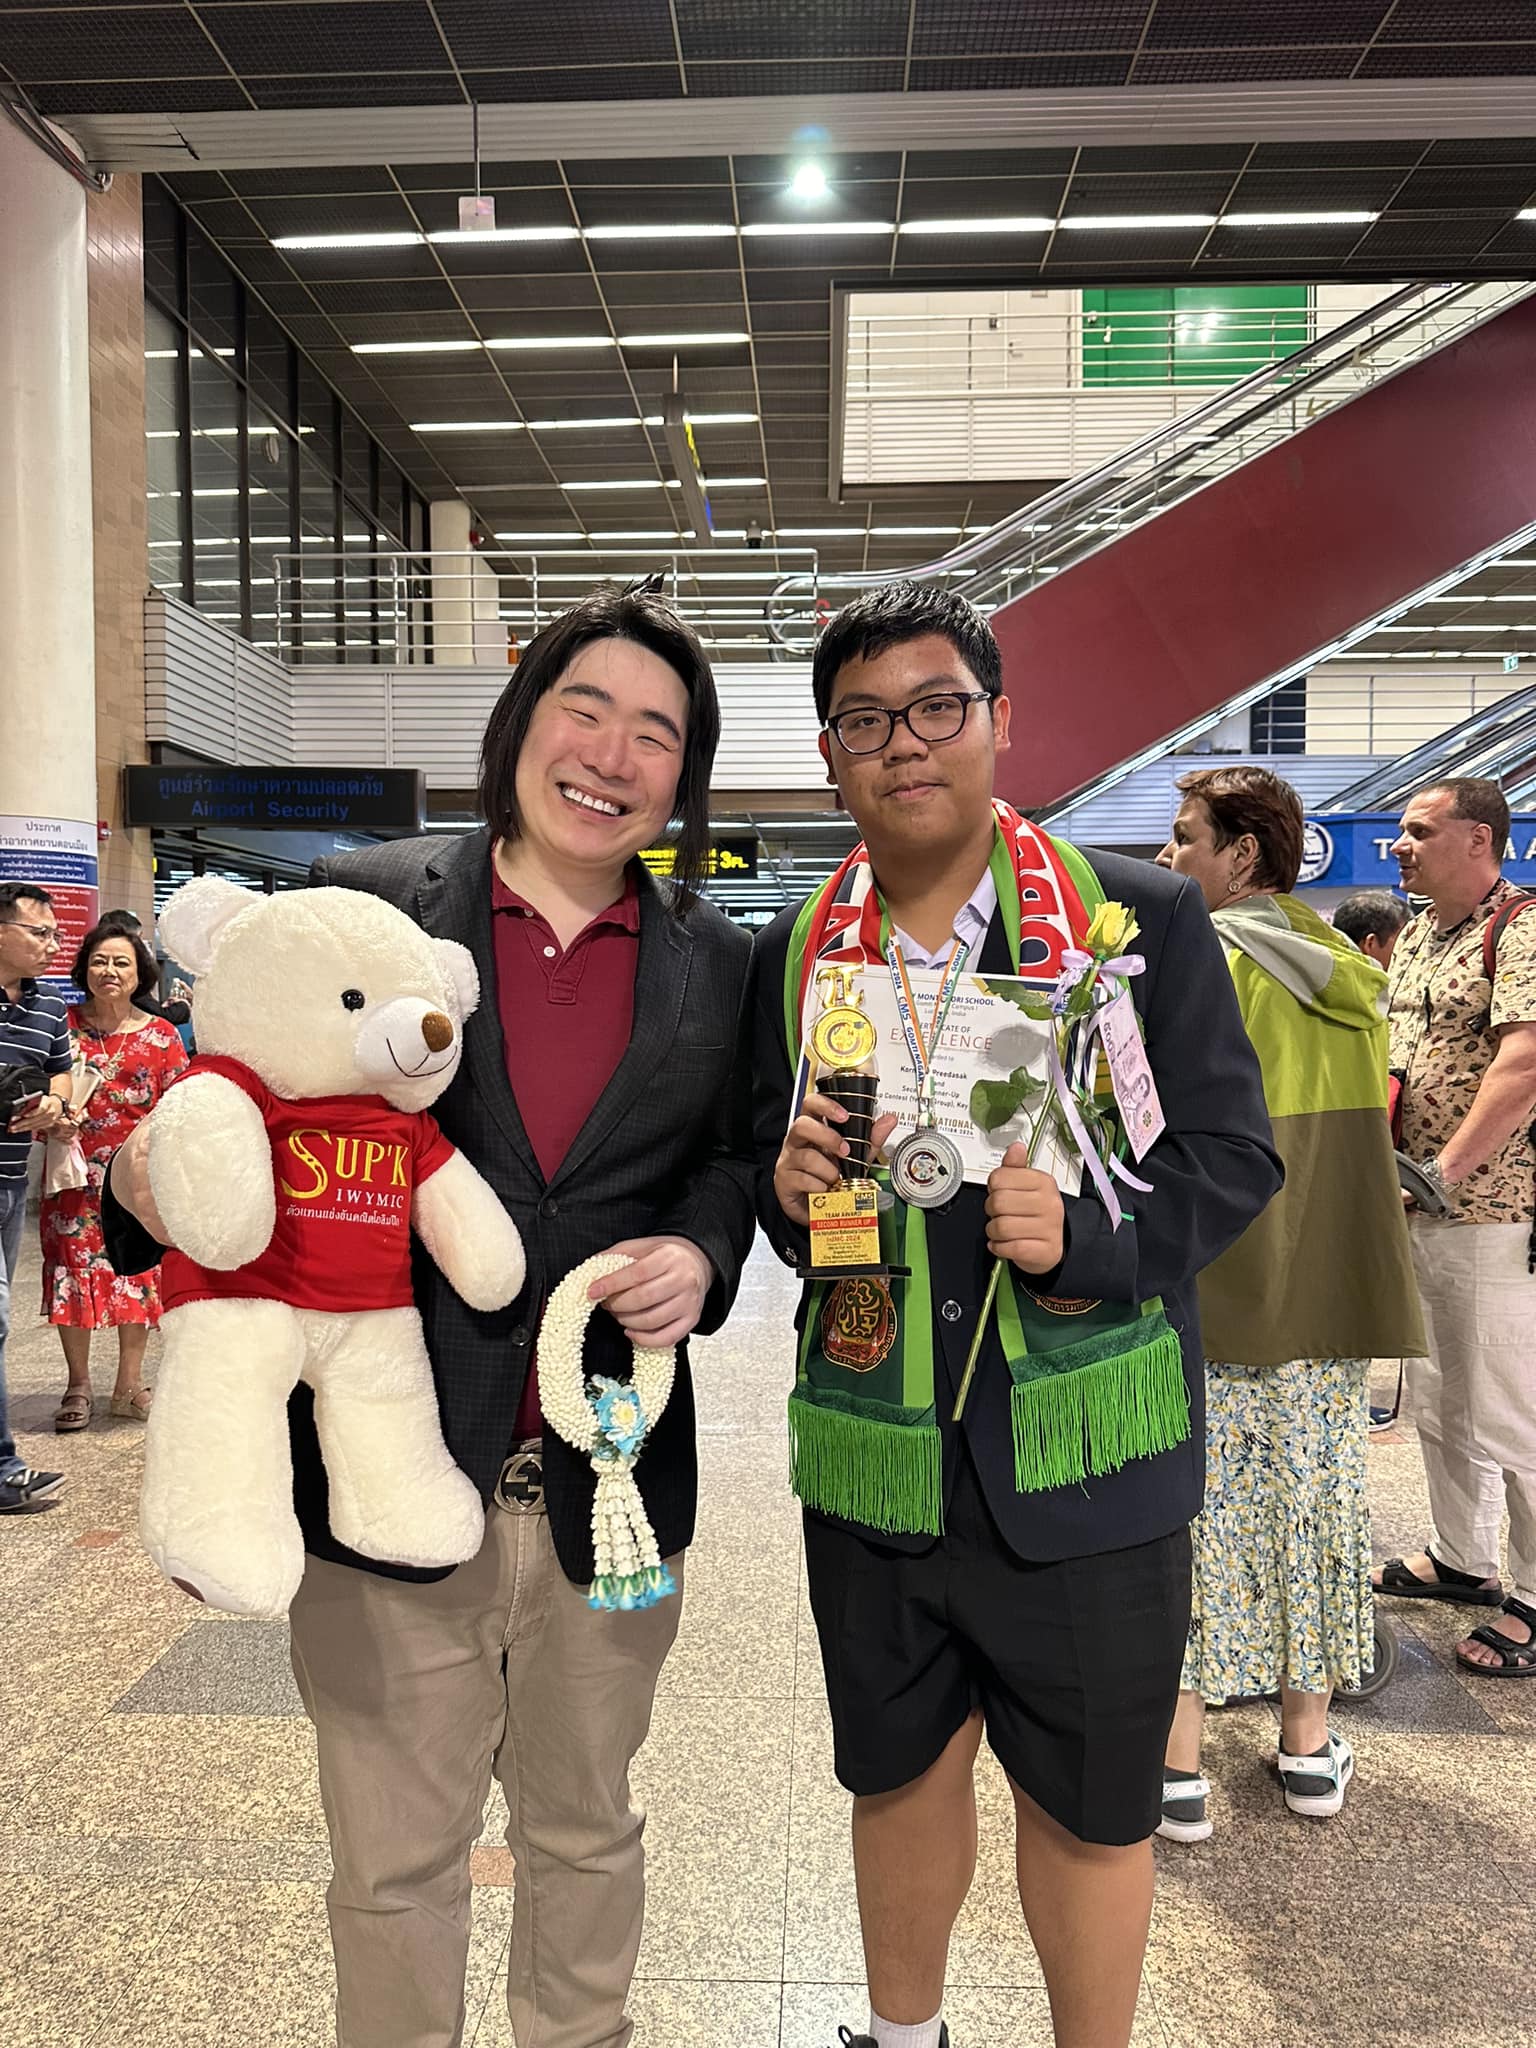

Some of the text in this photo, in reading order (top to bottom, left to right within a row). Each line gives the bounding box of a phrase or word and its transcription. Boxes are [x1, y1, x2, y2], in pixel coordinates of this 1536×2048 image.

[191, 801, 349, 821] Airport Security
[25, 821, 62, 833] ประกาศ
[940, 979, 954, 1003] CMS
[951, 947, 966, 972] GOMTI
[965, 997, 995, 1006] SCHOOL
[898, 996, 912, 1021] CMS
[906, 1027, 919, 1053] GOMTI
[956, 1101, 968, 1110] Key
[280, 1128, 408, 1199] SUP'K
[856, 1193, 874, 1201] CMS
